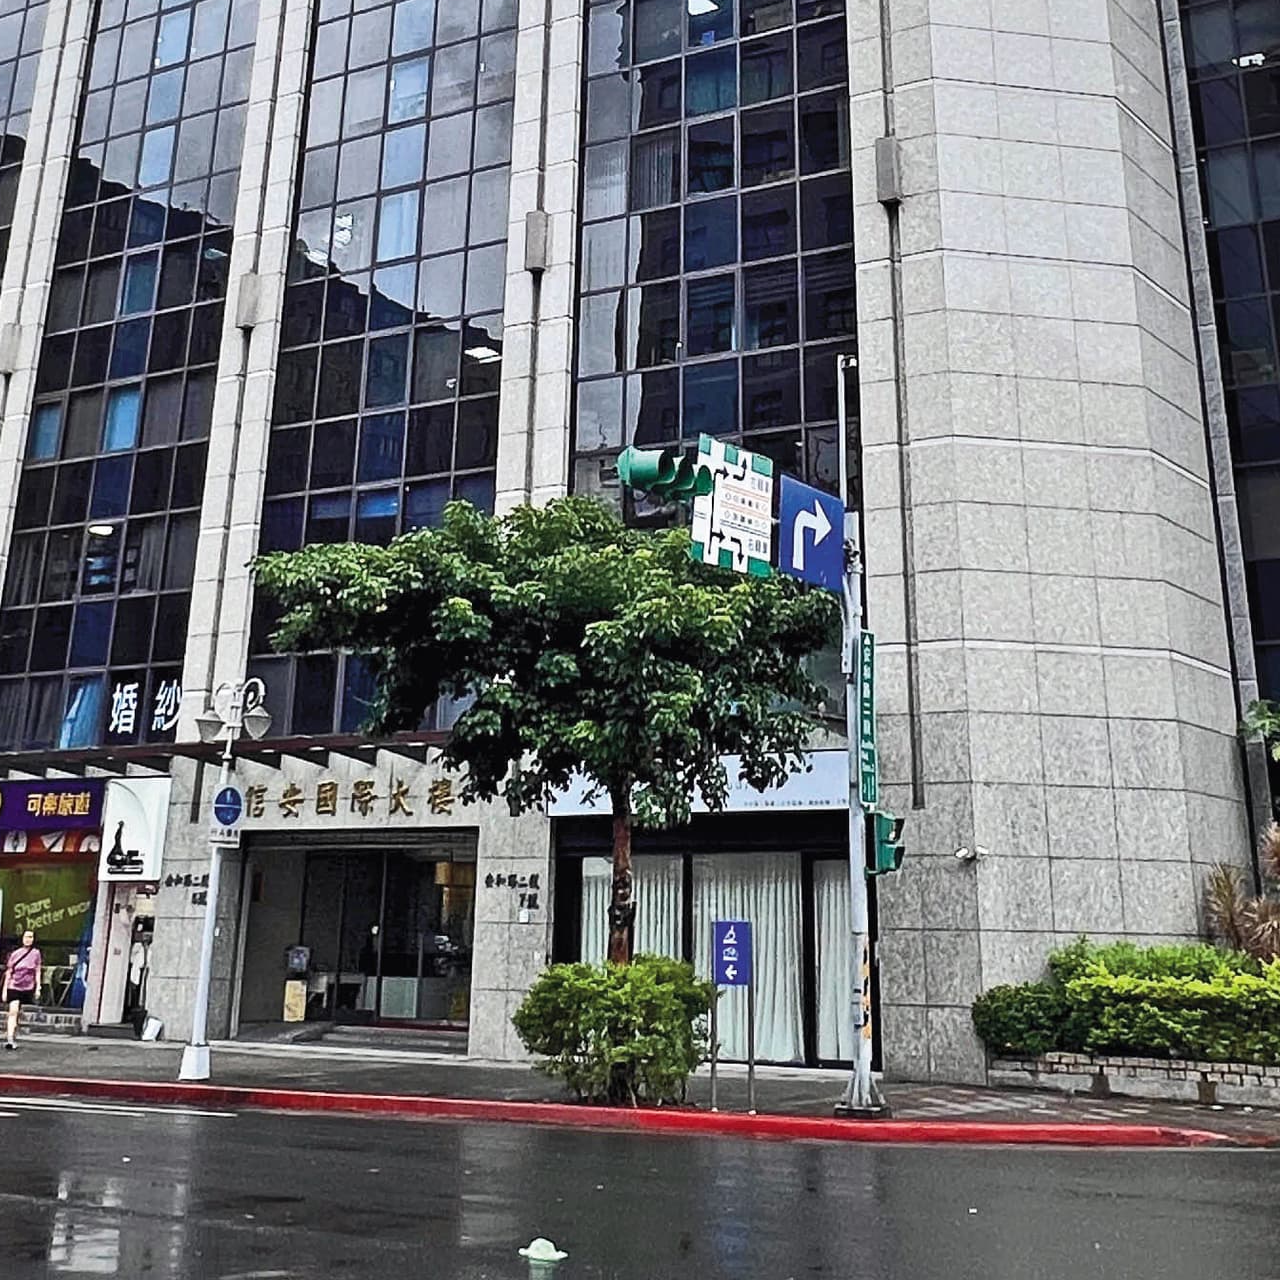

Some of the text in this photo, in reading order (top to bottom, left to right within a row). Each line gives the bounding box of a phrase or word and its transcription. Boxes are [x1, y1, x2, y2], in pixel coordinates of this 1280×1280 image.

[109, 679, 183, 735] 婚紗
[27, 792, 91, 816] 可樂旅遊
[245, 778, 456, 819] 信安國際大樓
[14, 897, 52, 919] Share
[26, 908, 66, 930] better
